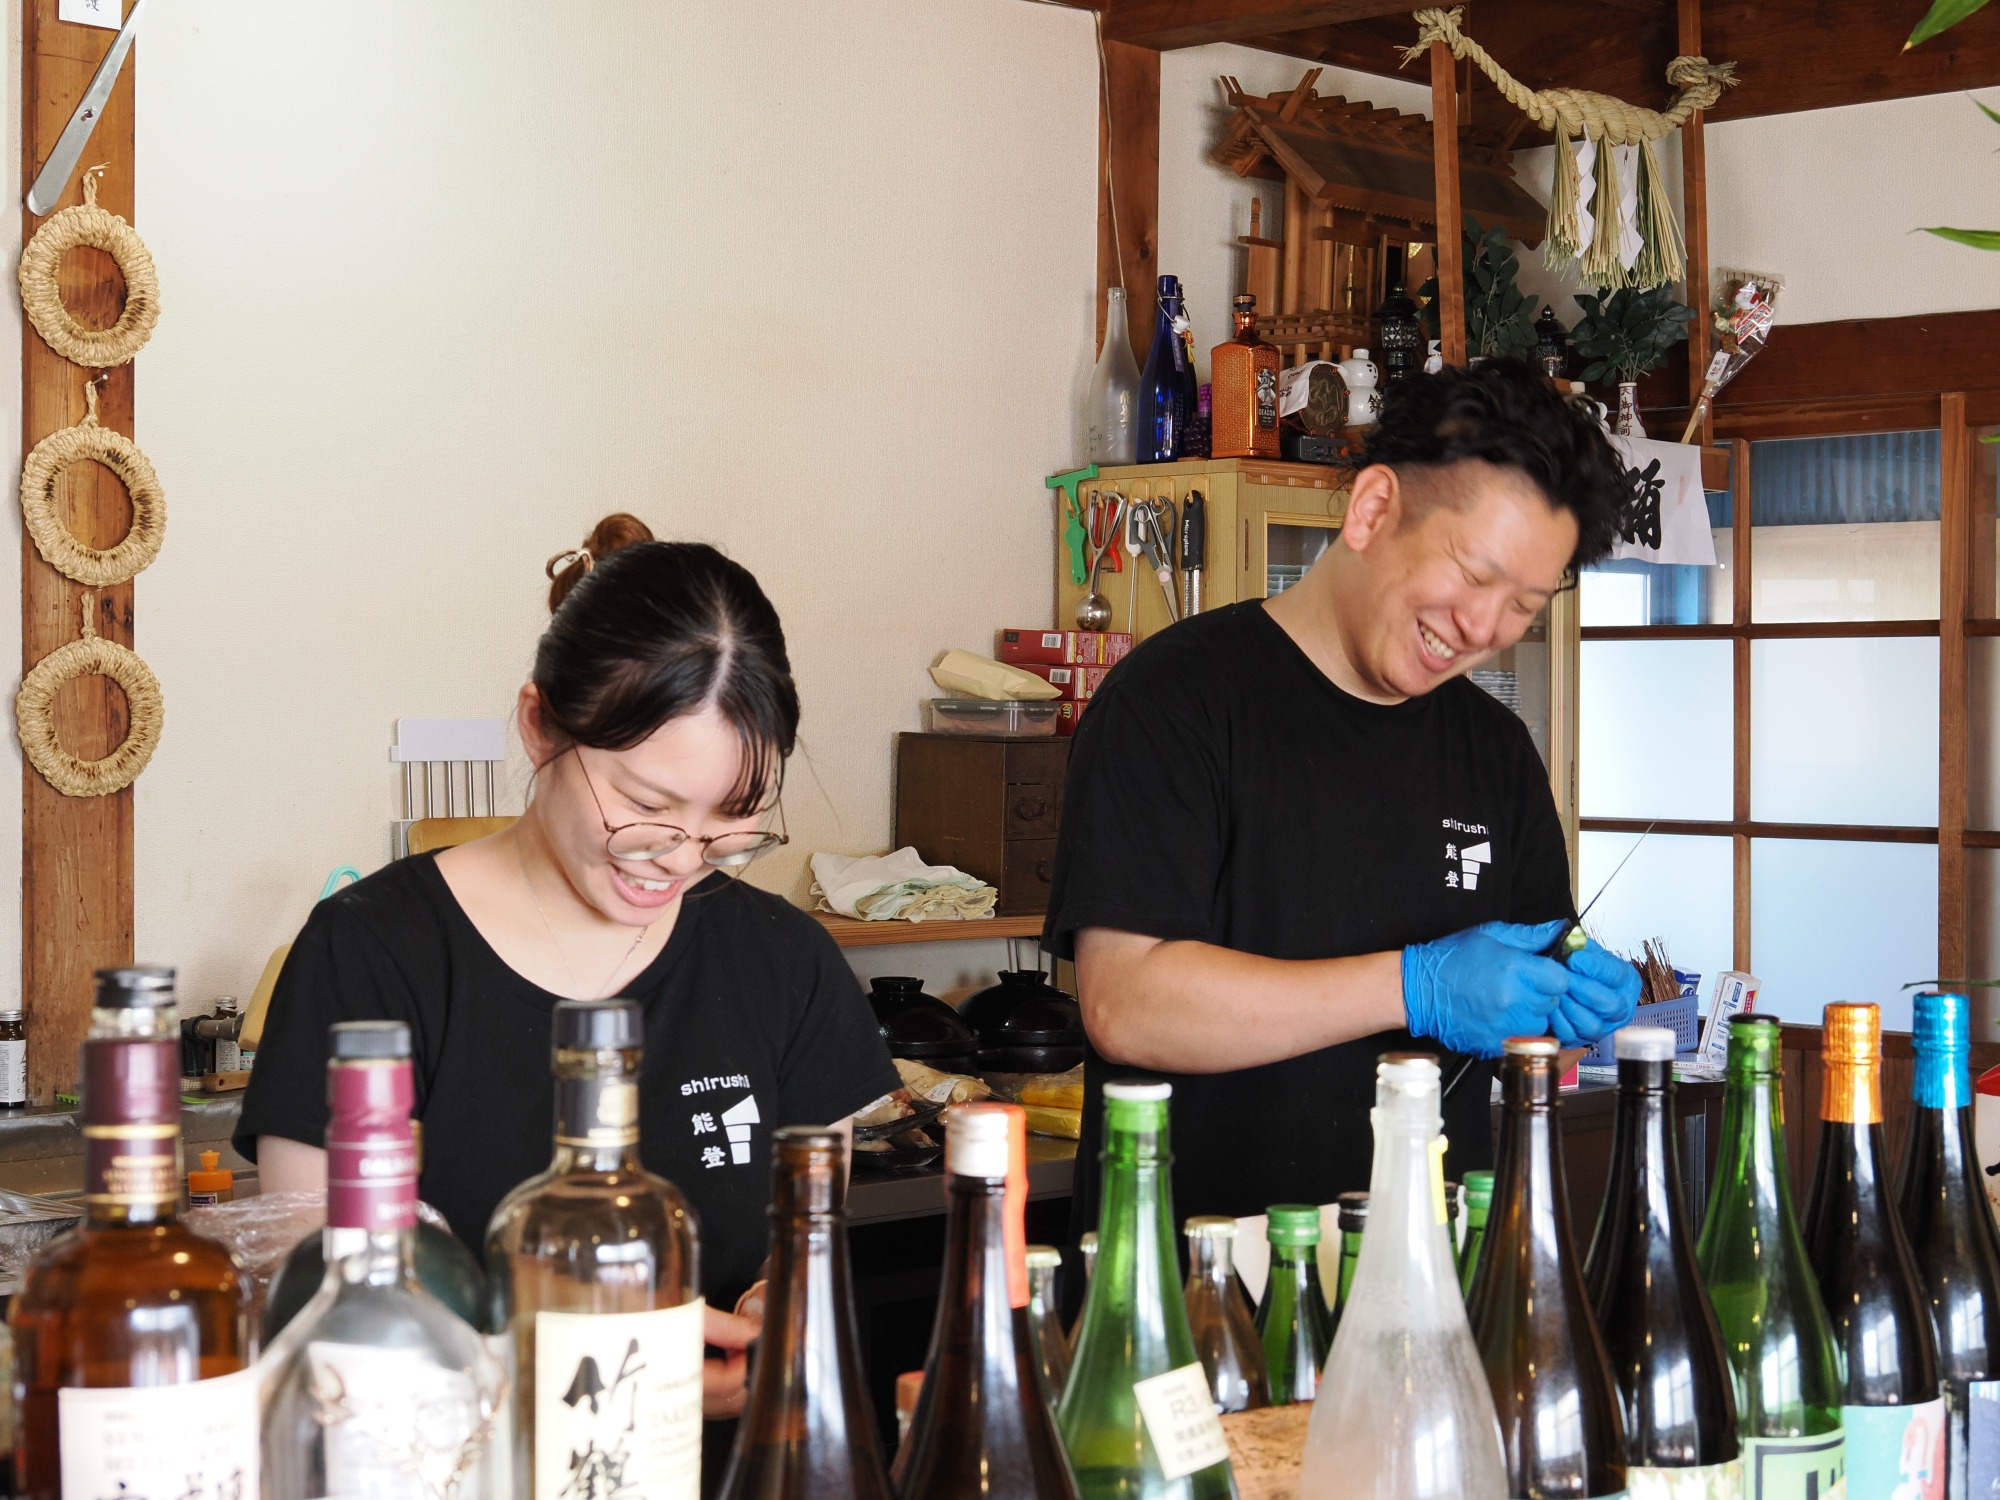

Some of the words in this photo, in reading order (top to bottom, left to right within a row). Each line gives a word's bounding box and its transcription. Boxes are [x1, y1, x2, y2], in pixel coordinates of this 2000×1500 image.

[1258, 408, 1276, 417] DEACON
[1445, 843, 1459, 888] 能登
[681, 1074, 750, 1096] shirushi
[691, 1112, 726, 1169] 能登
